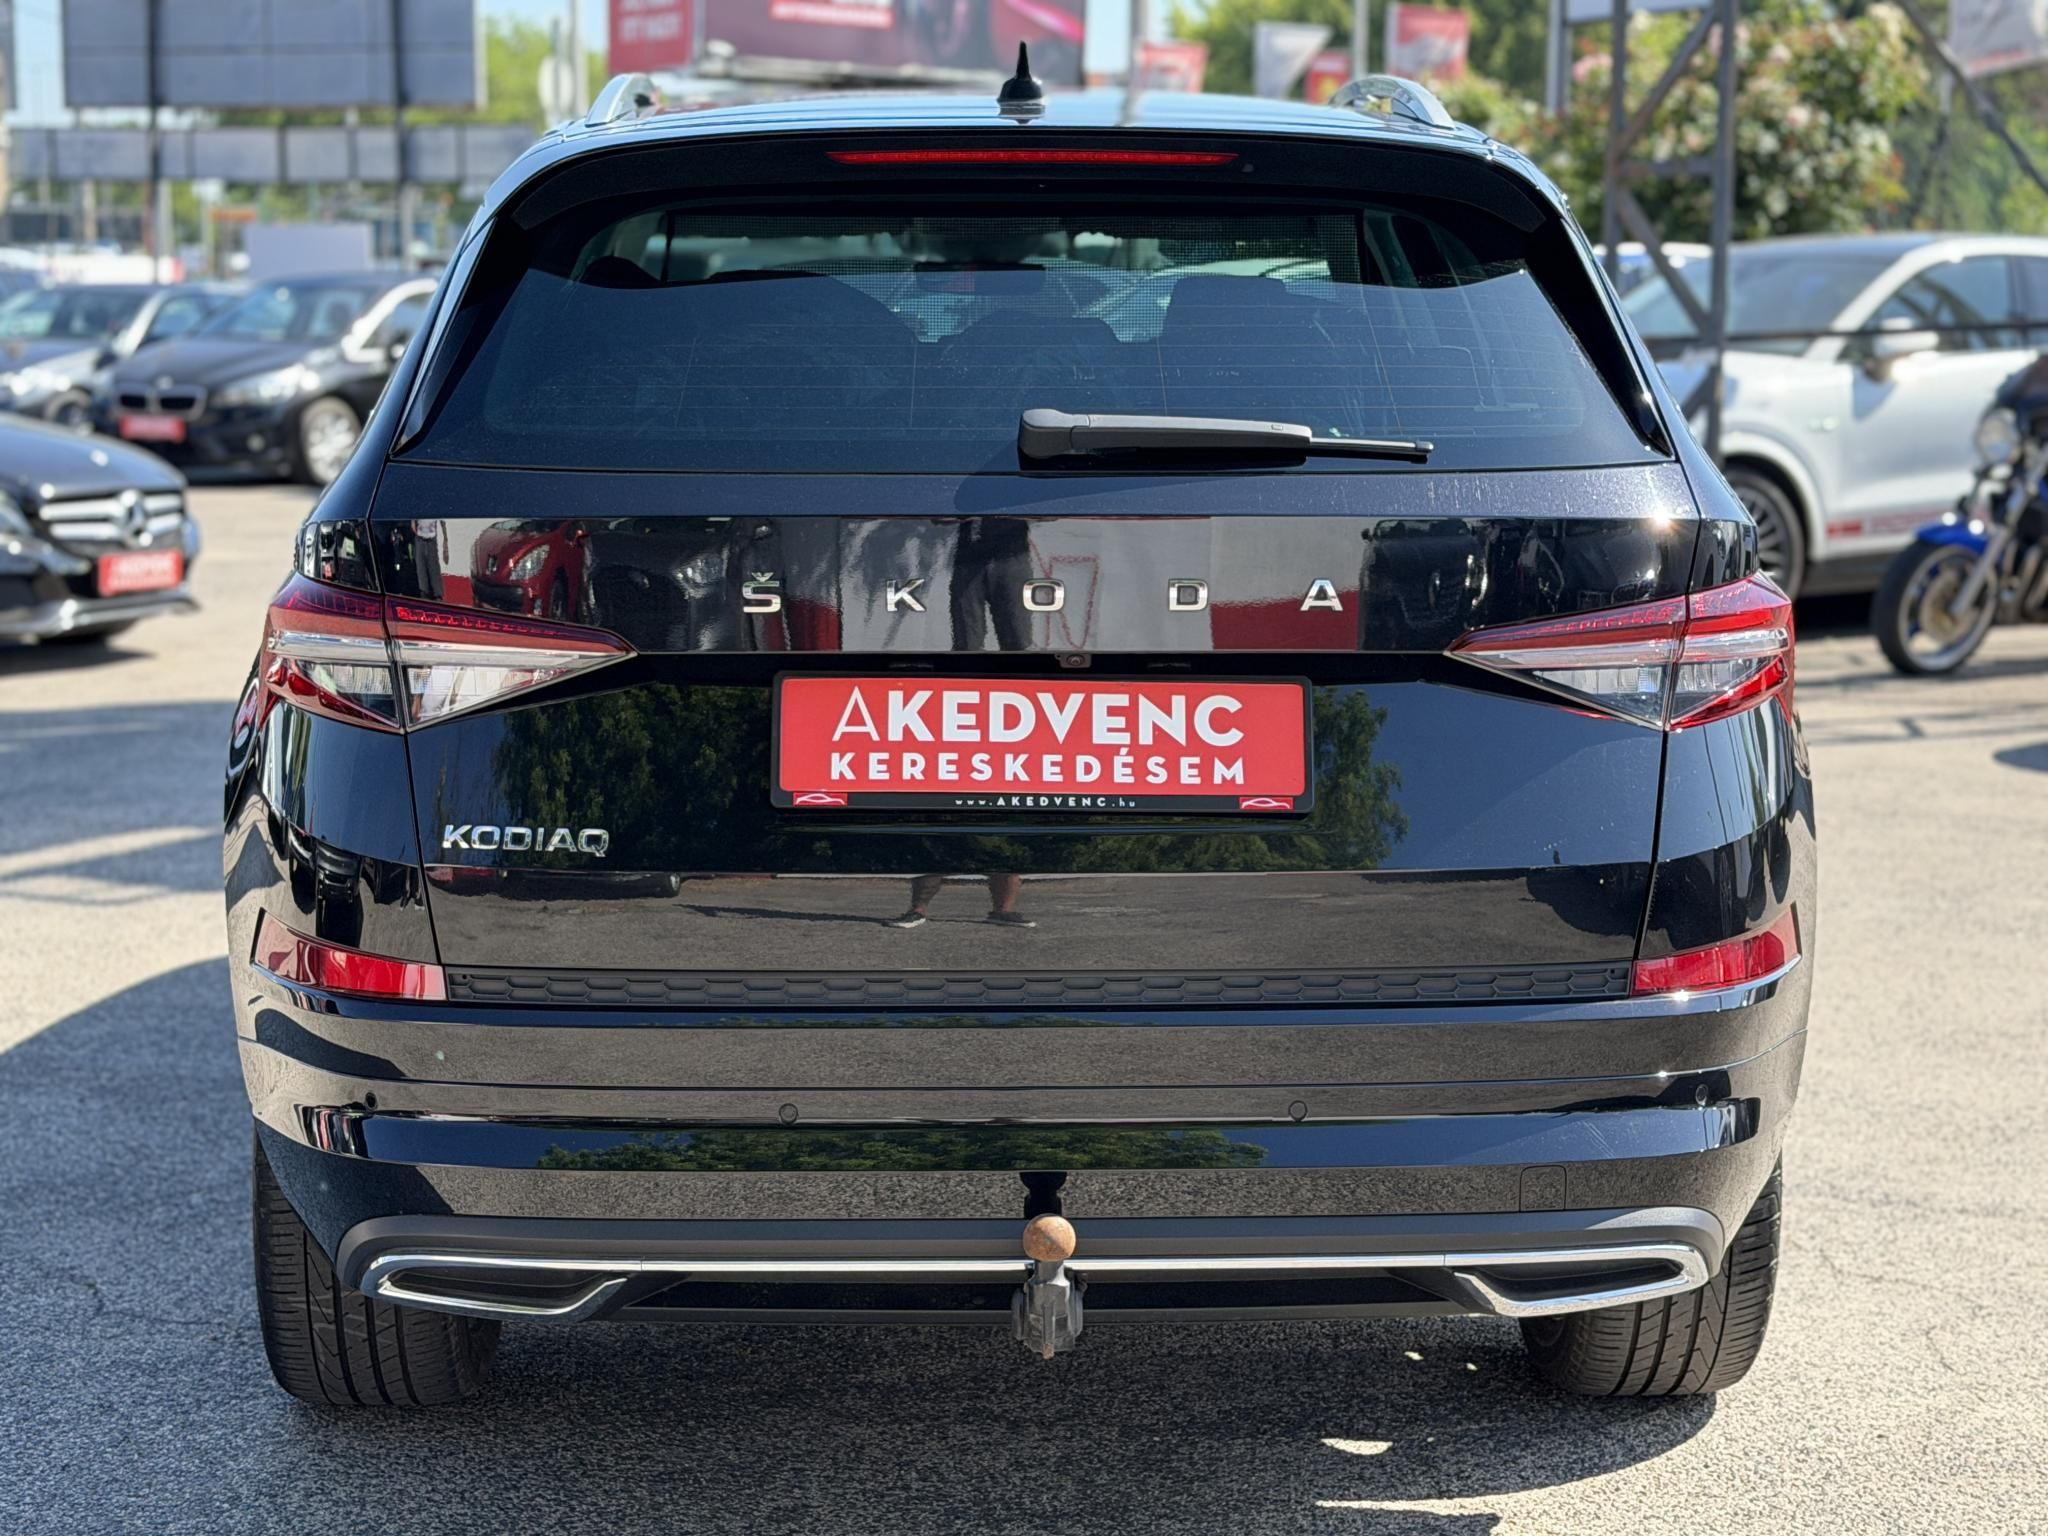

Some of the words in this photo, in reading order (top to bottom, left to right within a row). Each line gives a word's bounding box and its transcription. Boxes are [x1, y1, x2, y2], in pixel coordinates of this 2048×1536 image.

[742, 571, 1344, 613] ŠKODA
[830, 747, 1245, 785] KERESKEDÉSEM
[954, 796, 1137, 808] www.AKEDVENC.hu
[441, 824, 610, 858] KODIAQ
